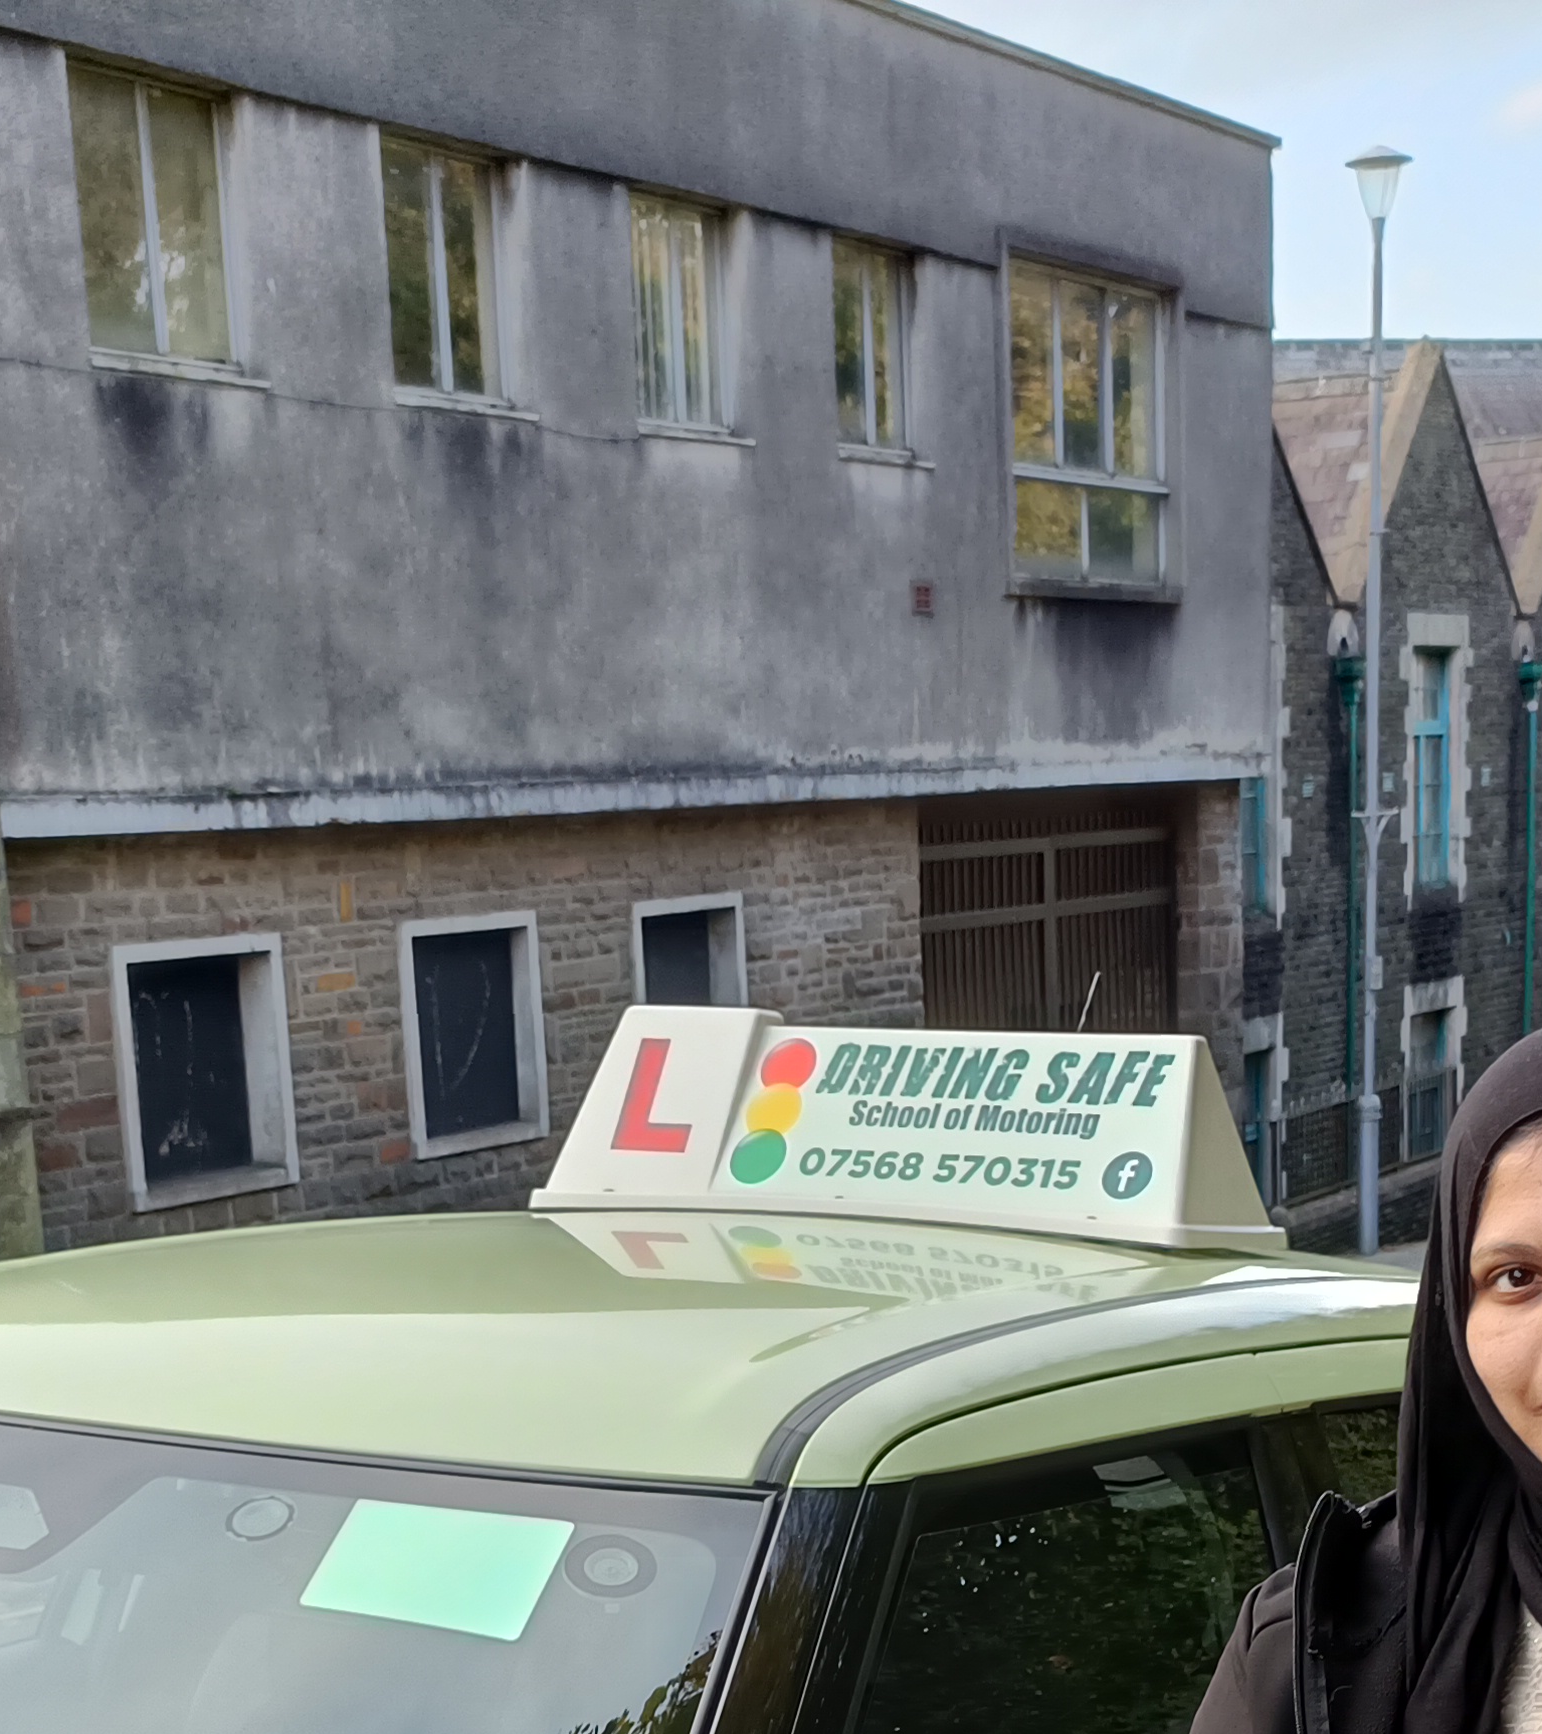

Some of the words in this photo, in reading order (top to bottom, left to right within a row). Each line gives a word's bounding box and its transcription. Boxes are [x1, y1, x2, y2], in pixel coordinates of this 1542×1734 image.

[610, 1037, 693, 1153] L
[815, 1042, 1030, 1102] DRIVING
[1035, 1050, 1176, 1107] SAFE
[848, 1100, 942, 1130] School
[943, 1104, 973, 1131] of
[974, 1104, 1101, 1140] Motoring
[799, 1146, 925, 1181] 07568
[932, 1153, 1081, 1190] 570315
